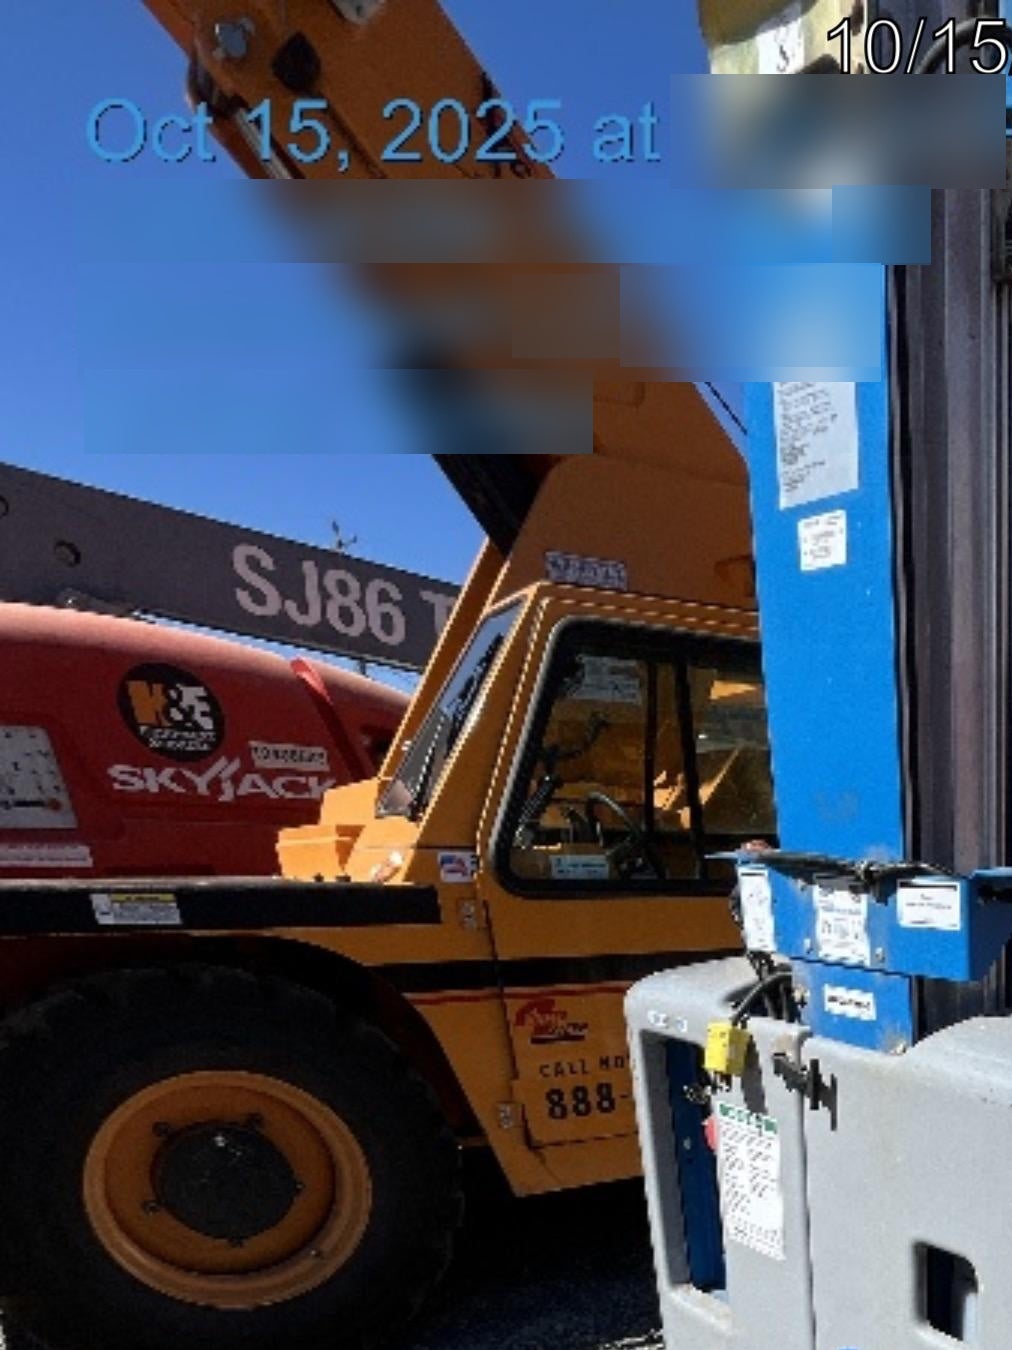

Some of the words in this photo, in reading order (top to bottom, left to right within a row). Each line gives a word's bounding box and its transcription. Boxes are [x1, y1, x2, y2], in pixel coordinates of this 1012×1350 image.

[232, 542, 406, 646] SJ86
[106, 756, 337, 802] SKYJACK
[540, 1058, 590, 1078] CALL
